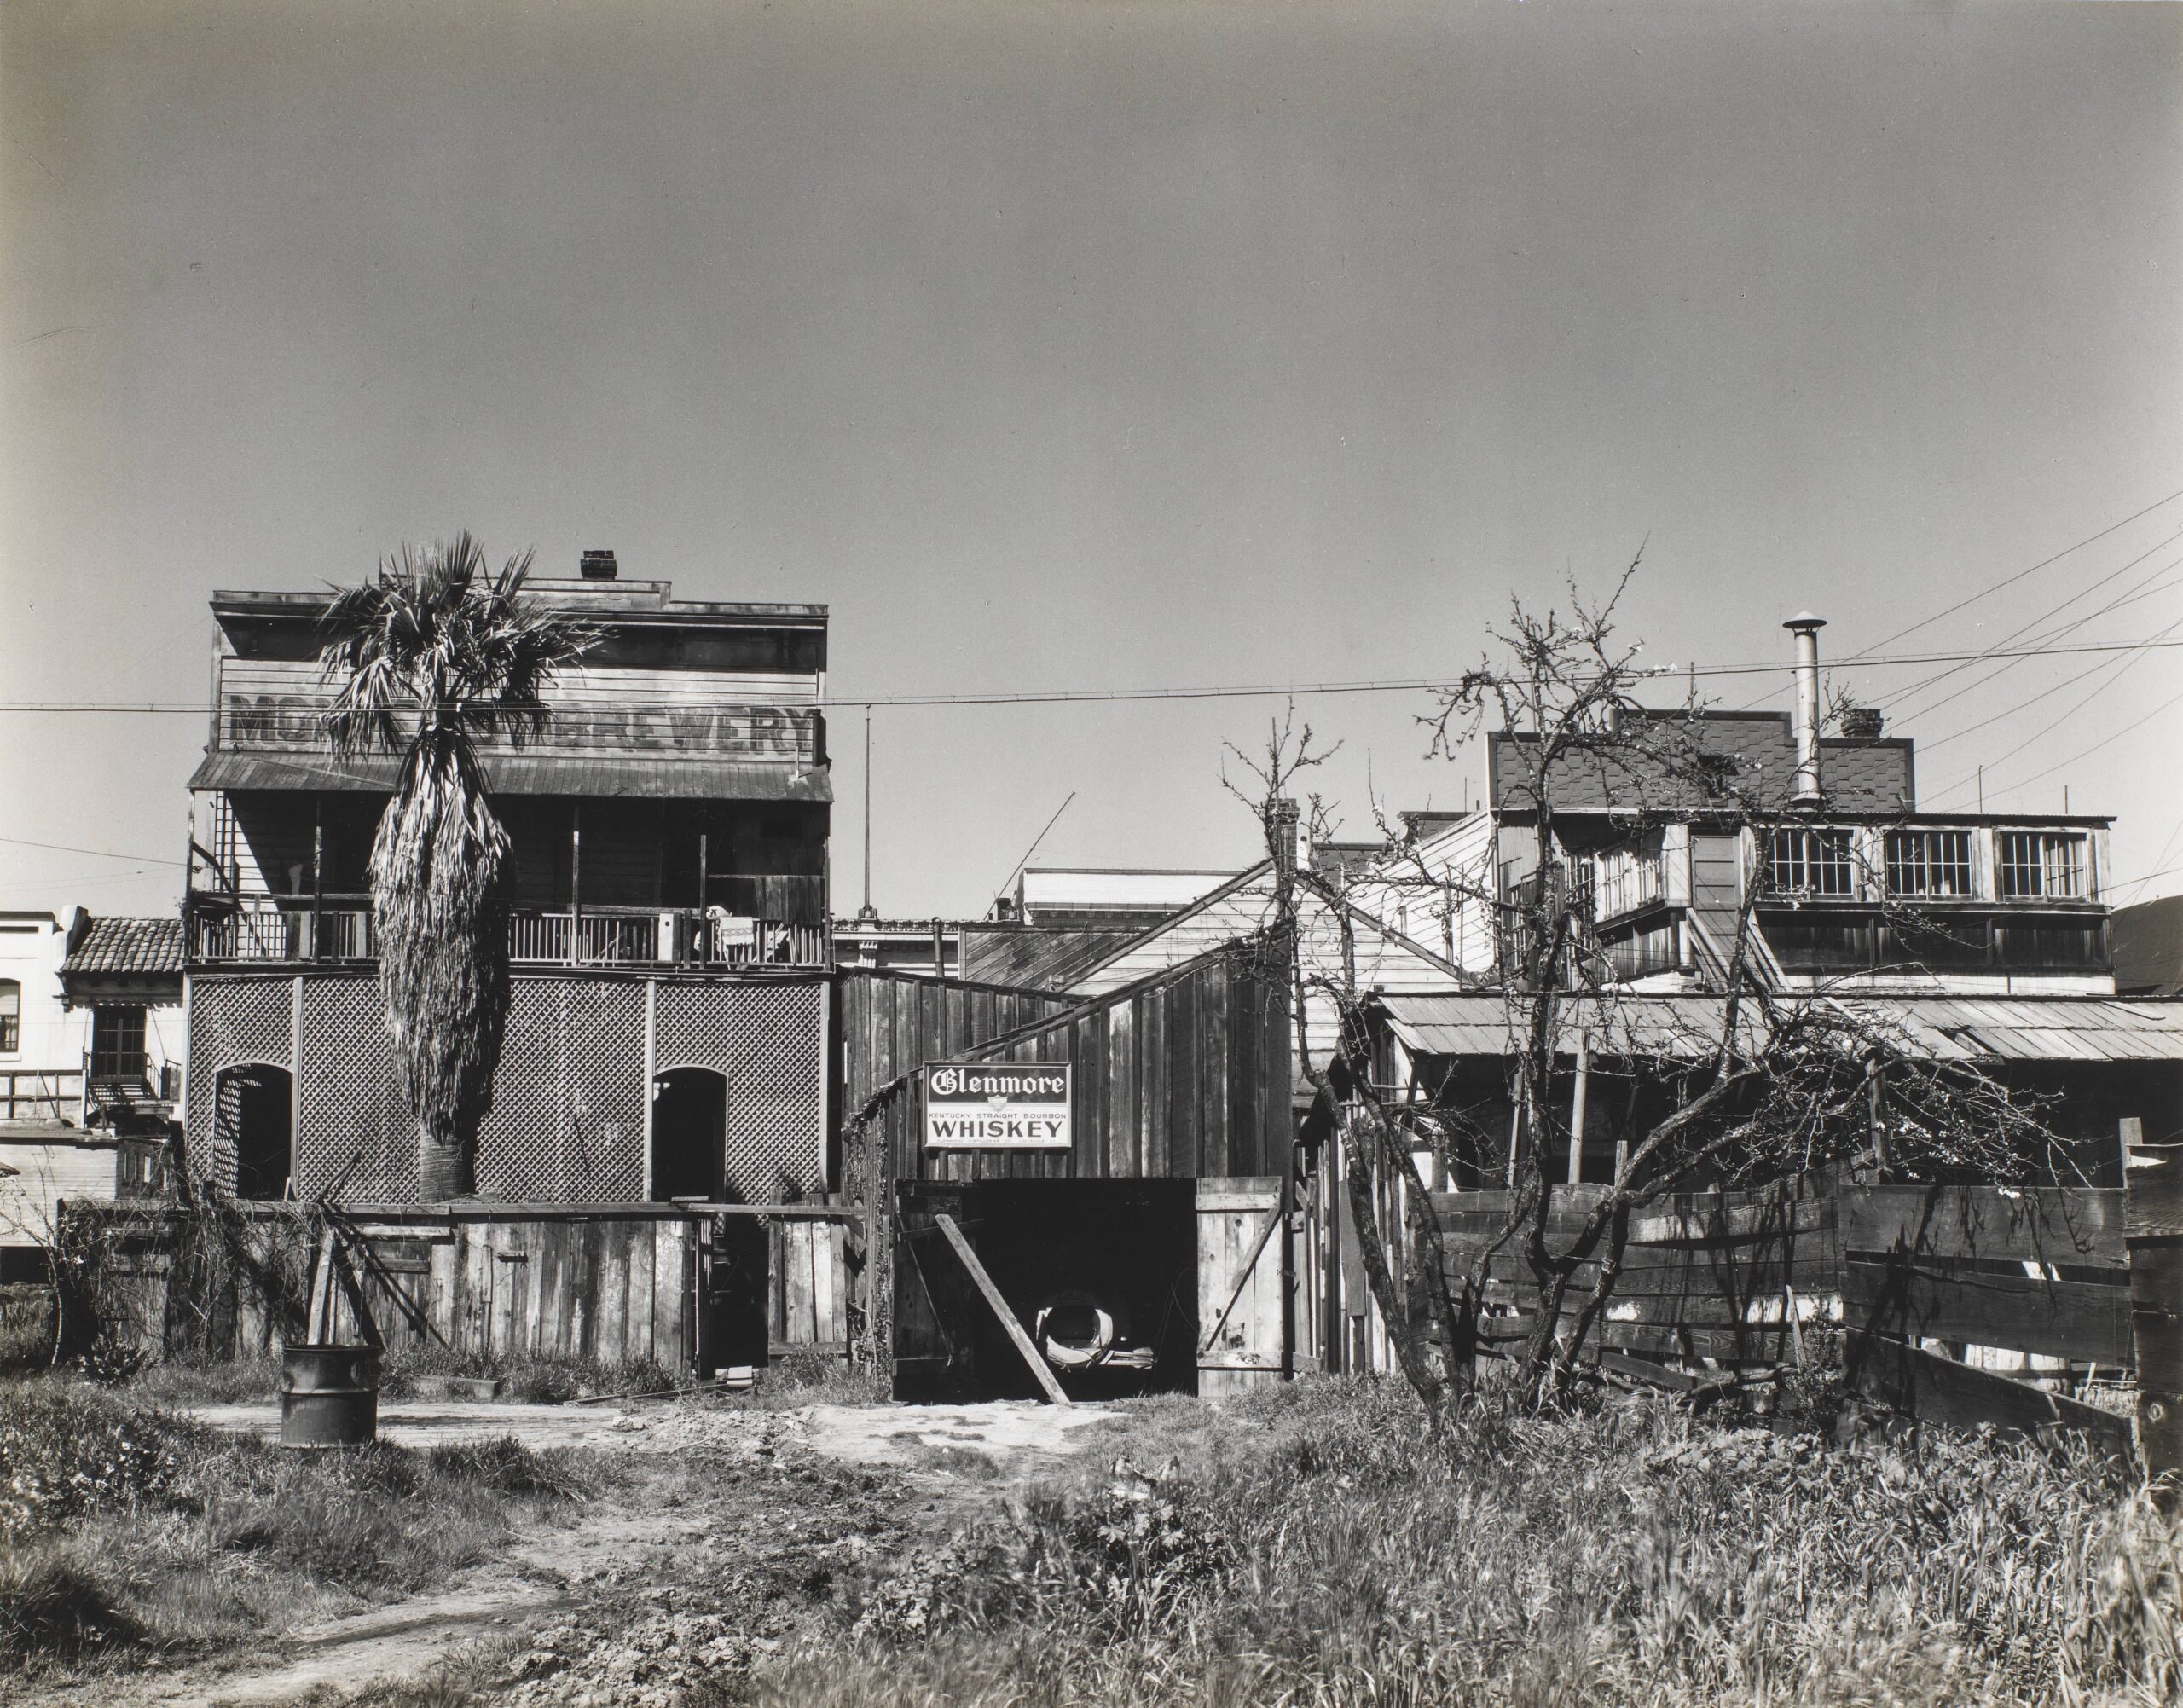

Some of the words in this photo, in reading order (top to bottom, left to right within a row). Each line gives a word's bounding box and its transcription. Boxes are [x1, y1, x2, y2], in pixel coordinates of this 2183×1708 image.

[553, 702, 813, 755] BREWERY
[930, 1068, 1065, 1096] Glenmore
[931, 1120, 1063, 1138] WHISKEY
